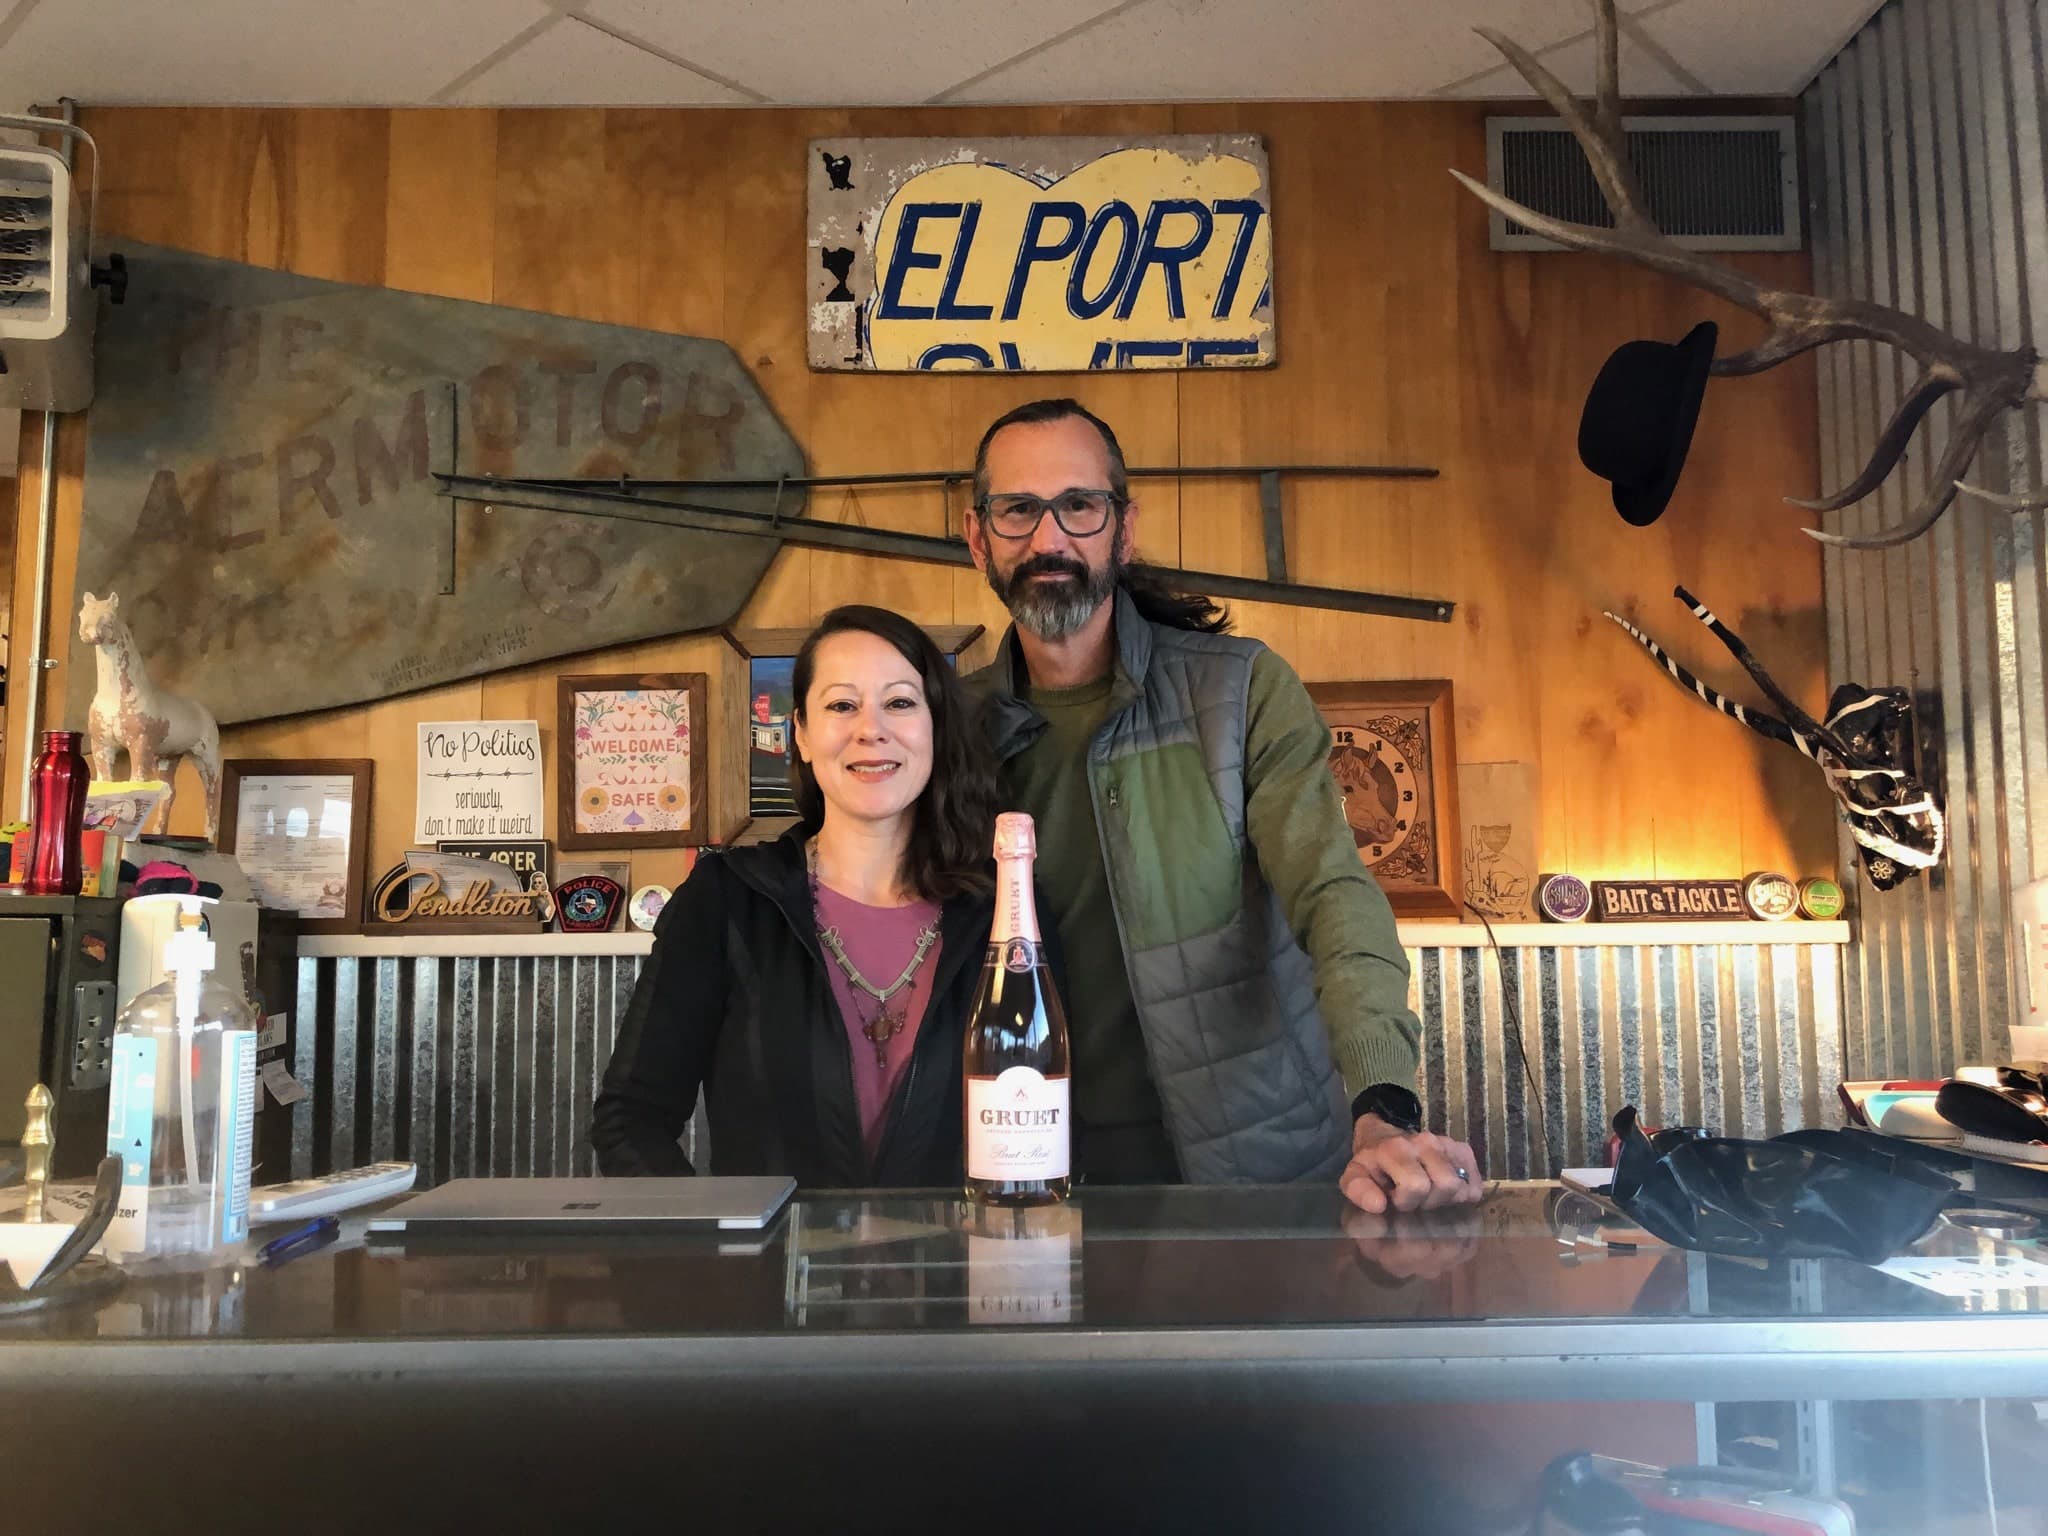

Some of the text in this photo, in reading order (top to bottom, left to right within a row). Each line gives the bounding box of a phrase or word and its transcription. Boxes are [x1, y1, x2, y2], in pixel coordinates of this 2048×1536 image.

[876, 198, 1272, 321] EL PORT
[1336, 731, 1354, 743] 12
[424, 728, 535, 763] No Politics
[590, 738, 676, 754] WELCOME
[1376, 740, 1383, 751] 1
[1394, 762, 1404, 773] 2
[455, 787, 504, 813] seriously,
[611, 792, 656, 807] SAFE
[1403, 790, 1414, 802] 3
[424, 813, 533, 836] don't make it weird
[1396, 820, 1407, 831] 4
[1372, 845, 1383, 857] 5
[378, 867, 546, 923] Pendleton
[563, 879, 613, 895] POLICE
[1603, 886, 1648, 914] BAIT
[1662, 886, 1740, 914] TACKLE
[980, 1108, 1060, 1126] GRUET
